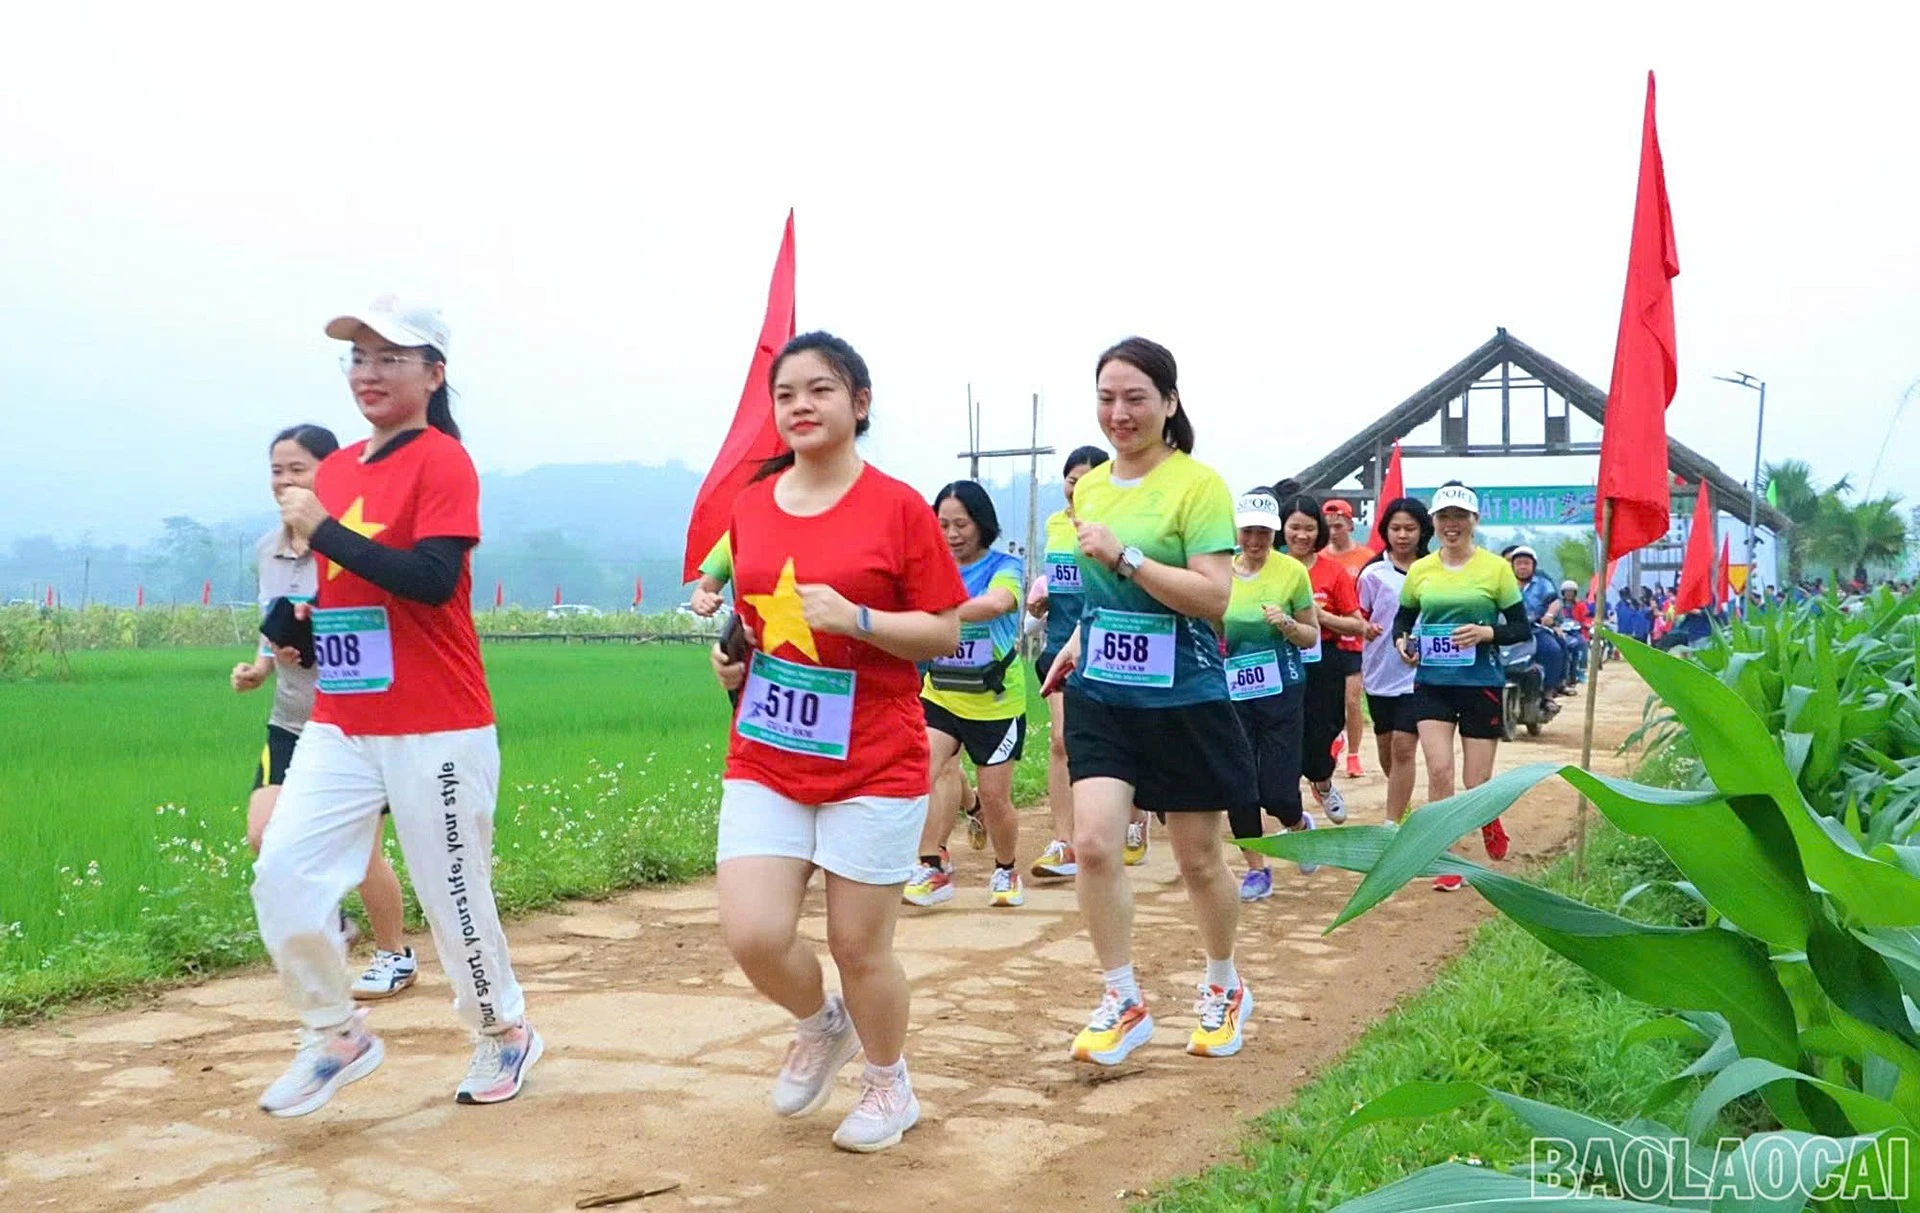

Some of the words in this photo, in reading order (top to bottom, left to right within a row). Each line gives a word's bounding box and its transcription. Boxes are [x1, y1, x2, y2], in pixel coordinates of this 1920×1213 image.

[1479, 489, 1502, 519] ẤT
[1508, 491, 1556, 519] PHÁT
[1055, 564, 1078, 581] 657
[314, 633, 360, 667] 508
[947, 641, 975, 659] 67
[1103, 631, 1149, 663] 658
[1237, 666, 1265, 686] 660
[764, 683, 819, 727] 510
[437, 761, 459, 806] style
[445, 813, 464, 853] your
[456, 896, 480, 947] yours
[466, 949, 491, 997] sport,
